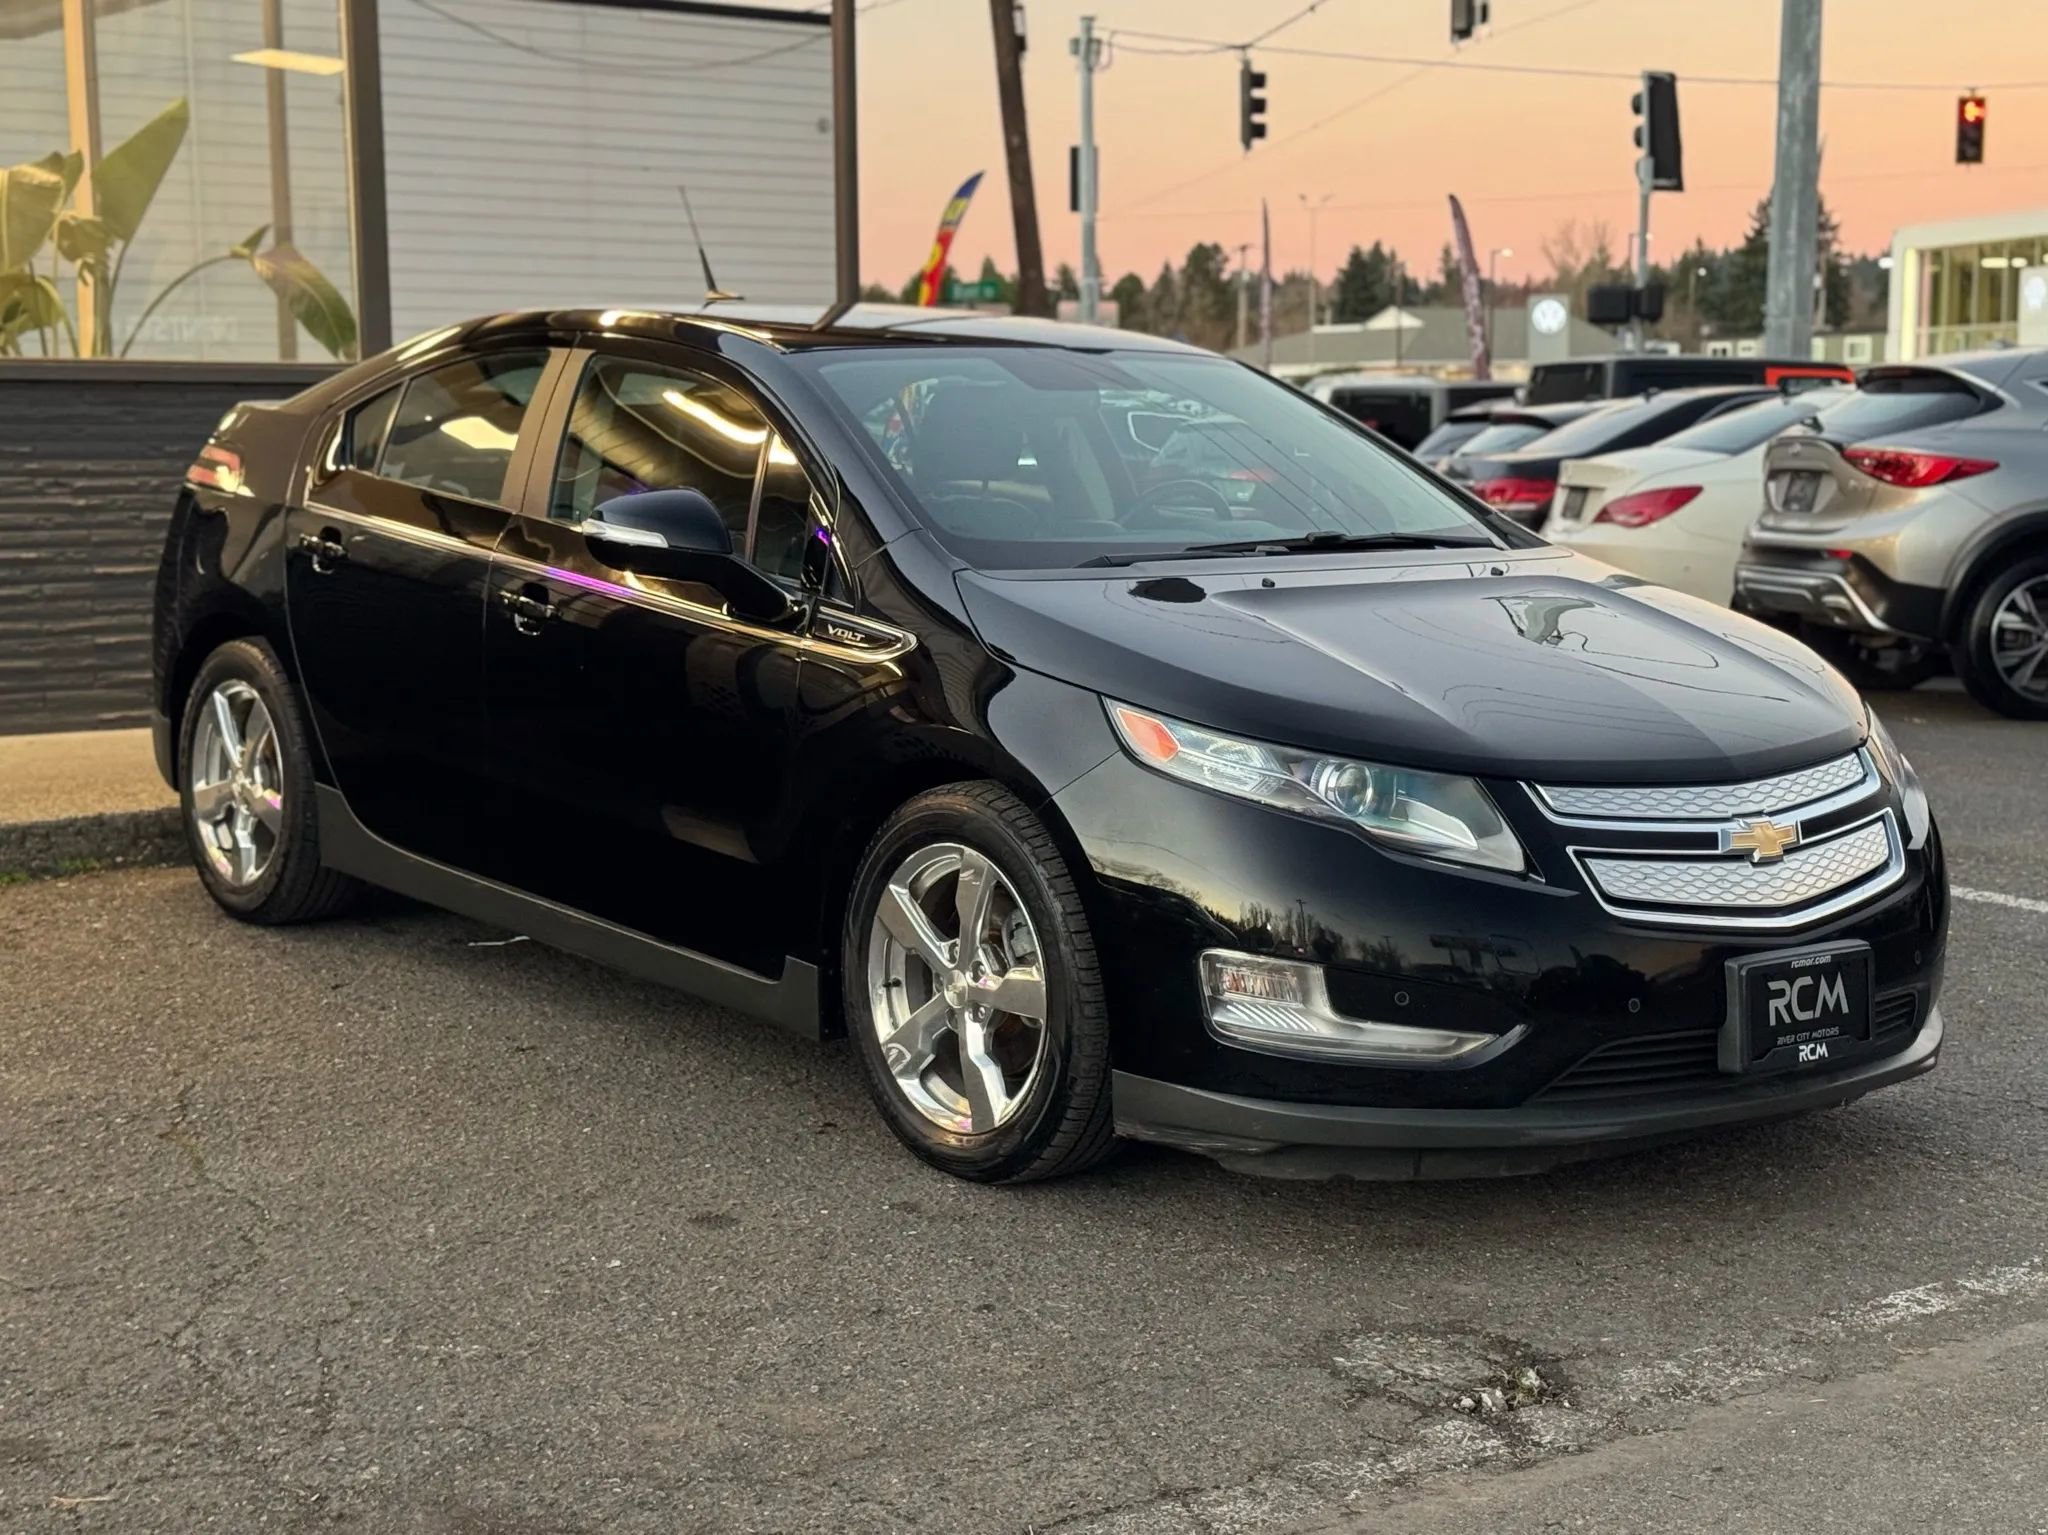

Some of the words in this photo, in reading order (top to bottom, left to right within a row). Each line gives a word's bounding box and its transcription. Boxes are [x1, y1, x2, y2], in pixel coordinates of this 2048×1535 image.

[828, 624, 866, 641] VOLT
[1768, 971, 1849, 1026] RCM
[1776, 1036, 1796, 1046] RIVER
[1797, 1031, 1811, 1043] CITY
[1811, 1027, 1839, 1038] MOTORS
[1798, 1042, 1828, 1062] RCM
